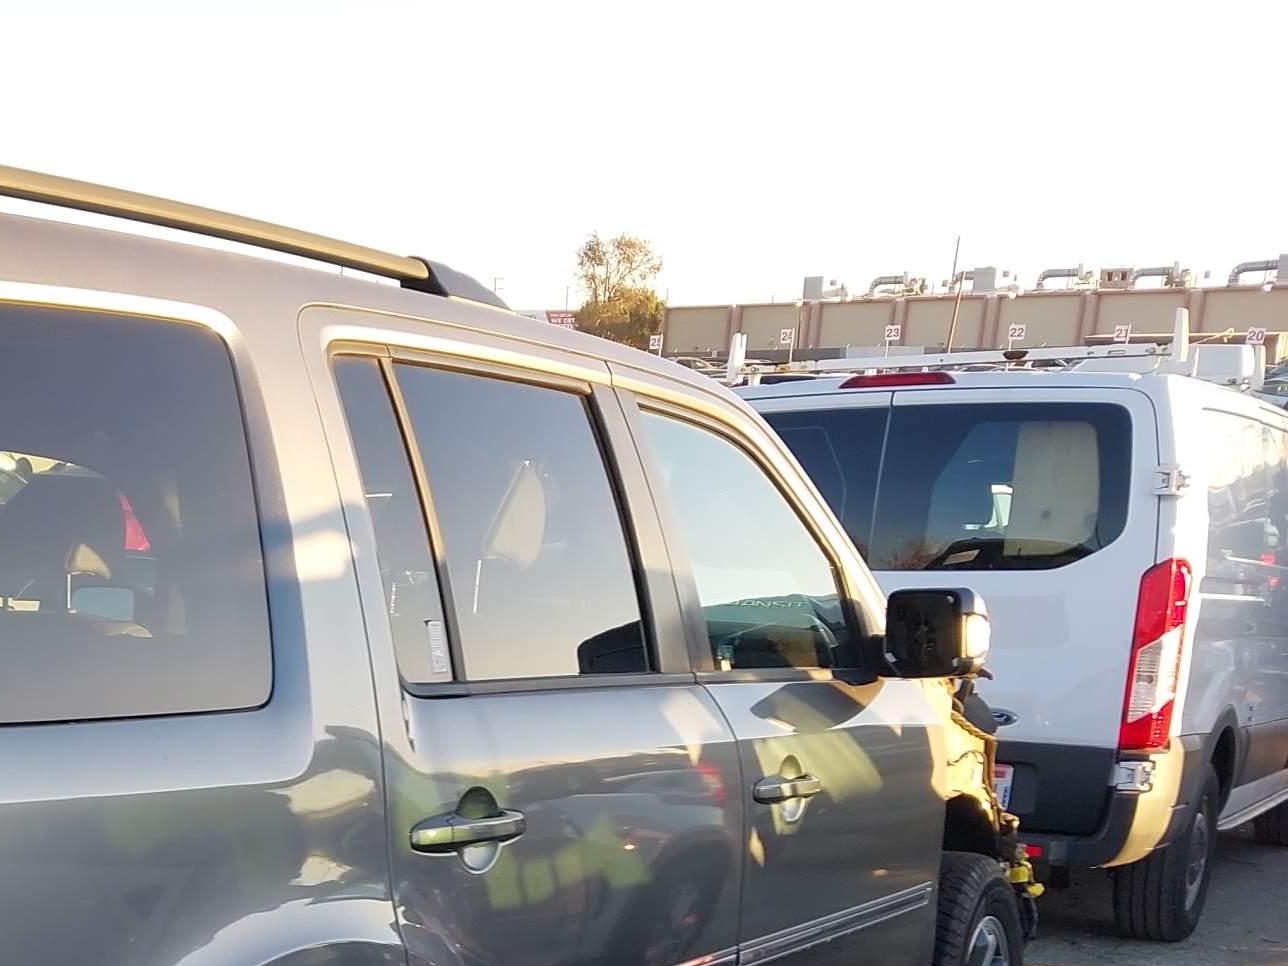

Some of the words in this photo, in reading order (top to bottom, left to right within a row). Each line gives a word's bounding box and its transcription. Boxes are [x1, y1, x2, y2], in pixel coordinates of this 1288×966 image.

[886, 328, 899, 337] 23
[1010, 328, 1024, 337] 22
[1248, 331, 1264, 341] 20
